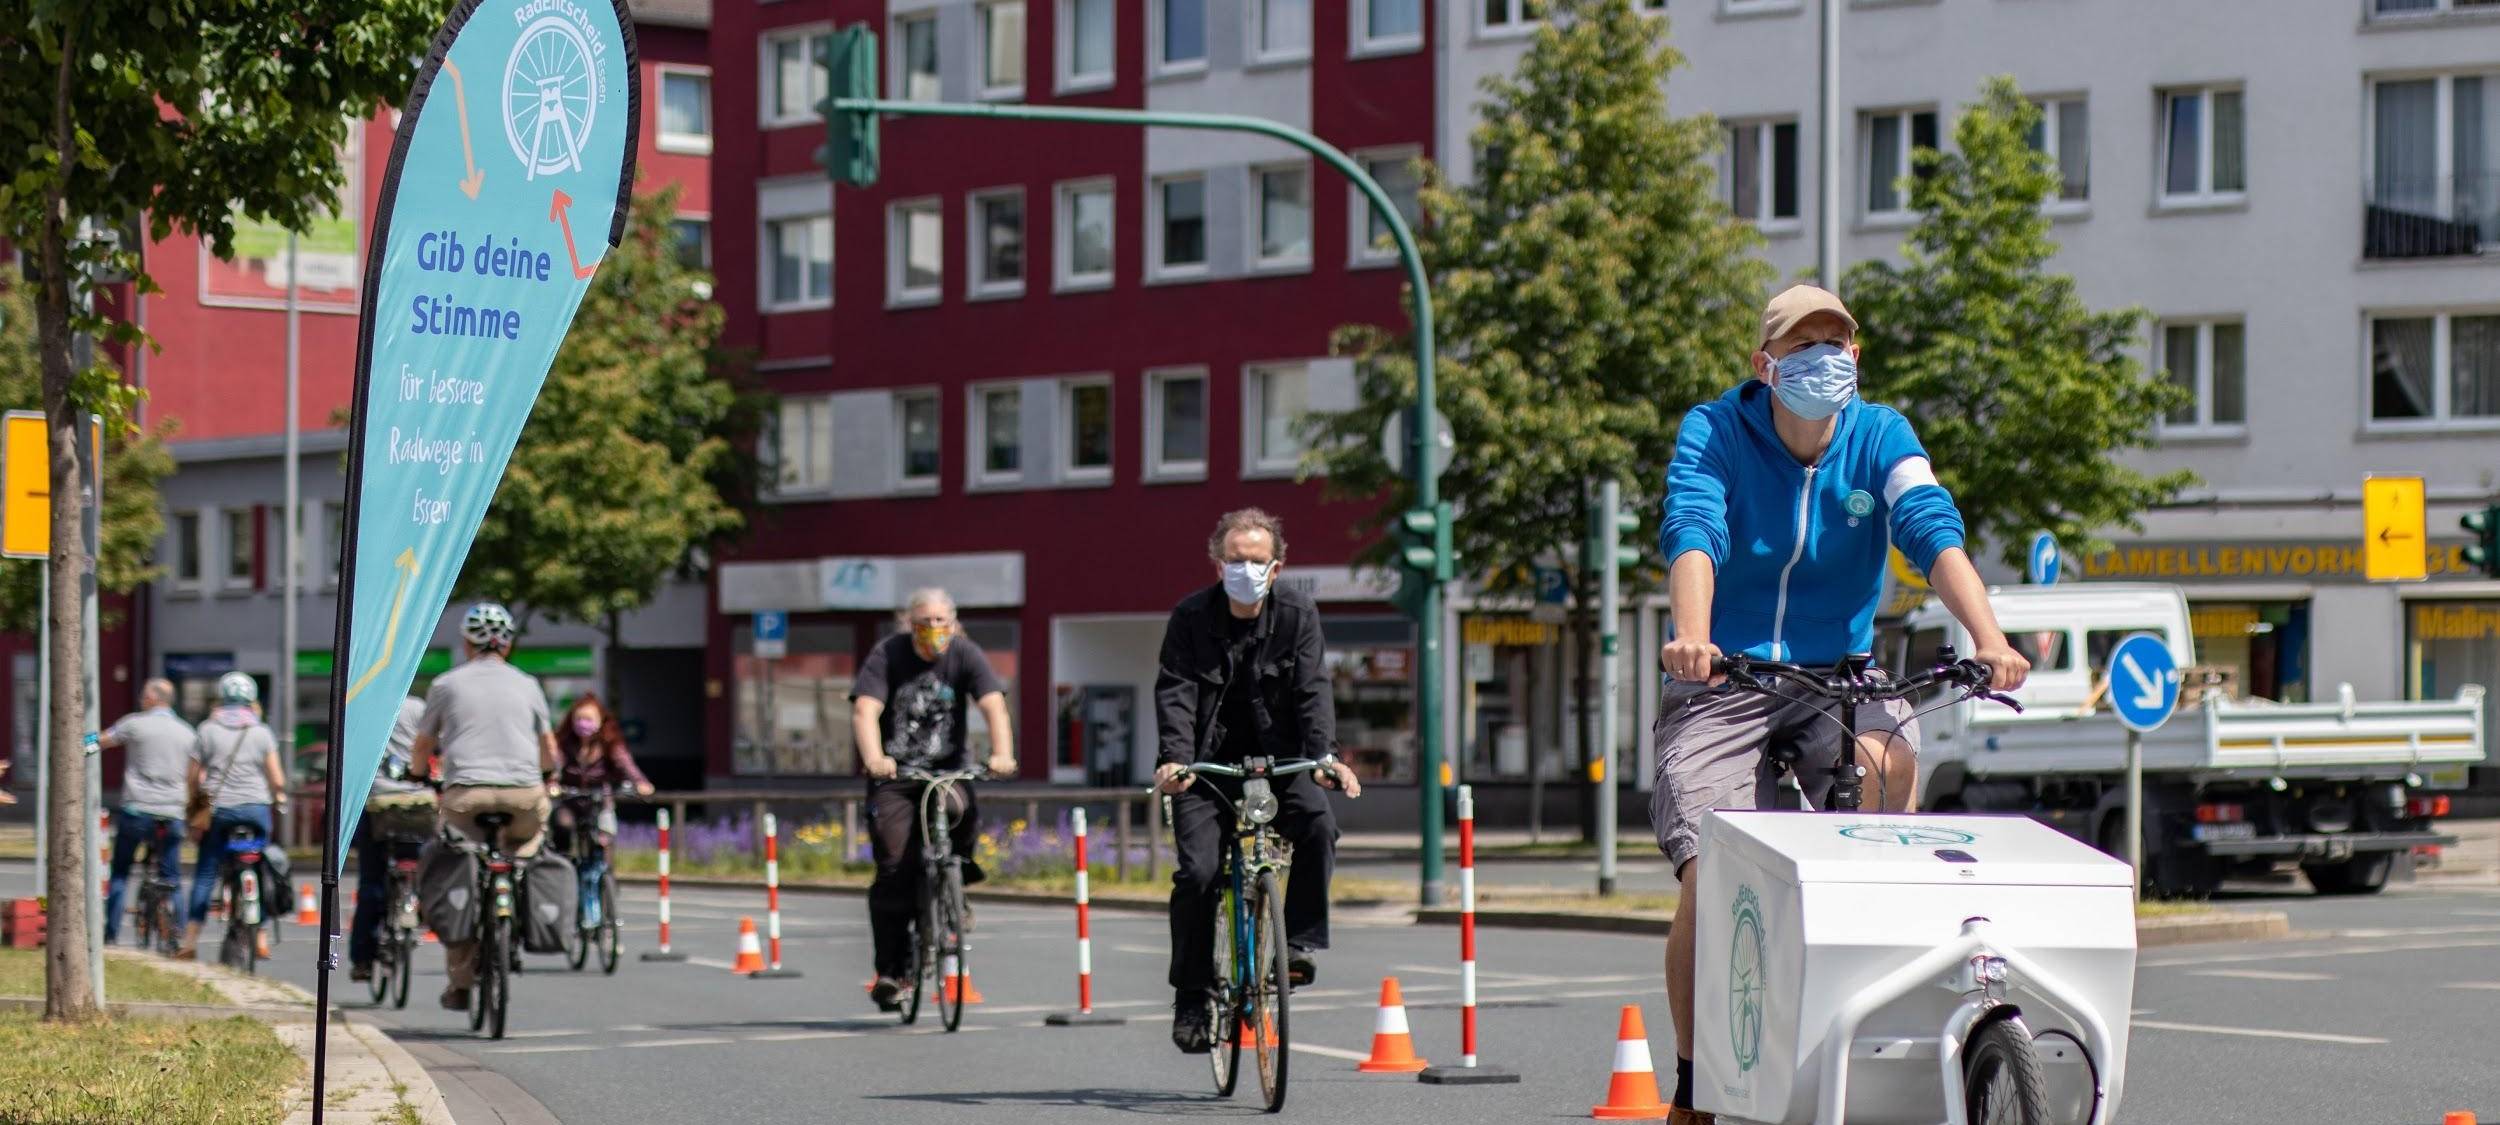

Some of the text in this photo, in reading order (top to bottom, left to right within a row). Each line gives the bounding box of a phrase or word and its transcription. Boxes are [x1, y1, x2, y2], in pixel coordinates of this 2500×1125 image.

[597, 57, 606, 104] Essen
[417, 230, 551, 282] Gib deine
[411, 293, 520, 340] Stimme
[429, 370, 485, 405] bessere
[389, 426, 484, 475] Radwege in
[412, 488, 452, 525] Essen
[2084, 545, 2470, 577] LAMELLENVORHGE
